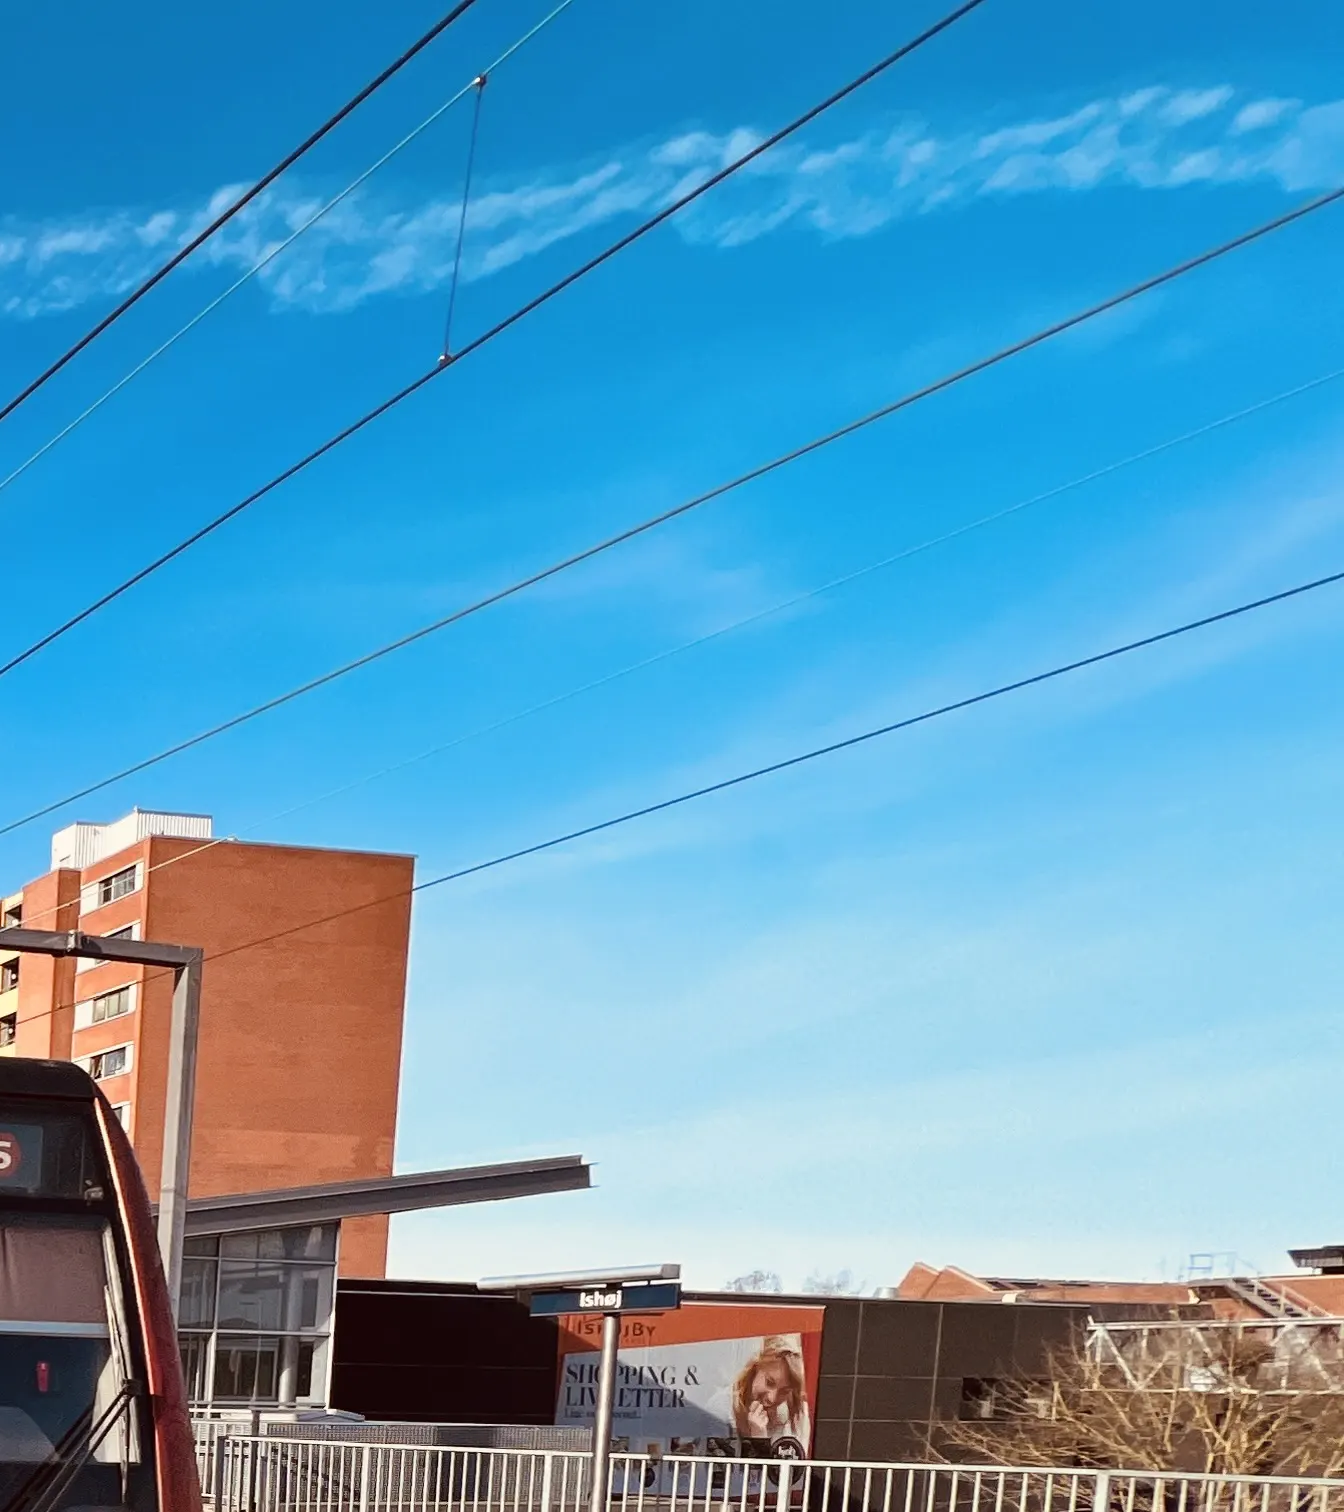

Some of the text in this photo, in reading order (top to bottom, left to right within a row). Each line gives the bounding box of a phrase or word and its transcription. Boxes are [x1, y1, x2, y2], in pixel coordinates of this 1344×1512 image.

[579, 1289, 623, 1309] Ishøj
[577, 1319, 657, 1337] ISJBY
[684, 1364, 701, 1386] &
[565, 1386, 686, 1408] LIVETTER
